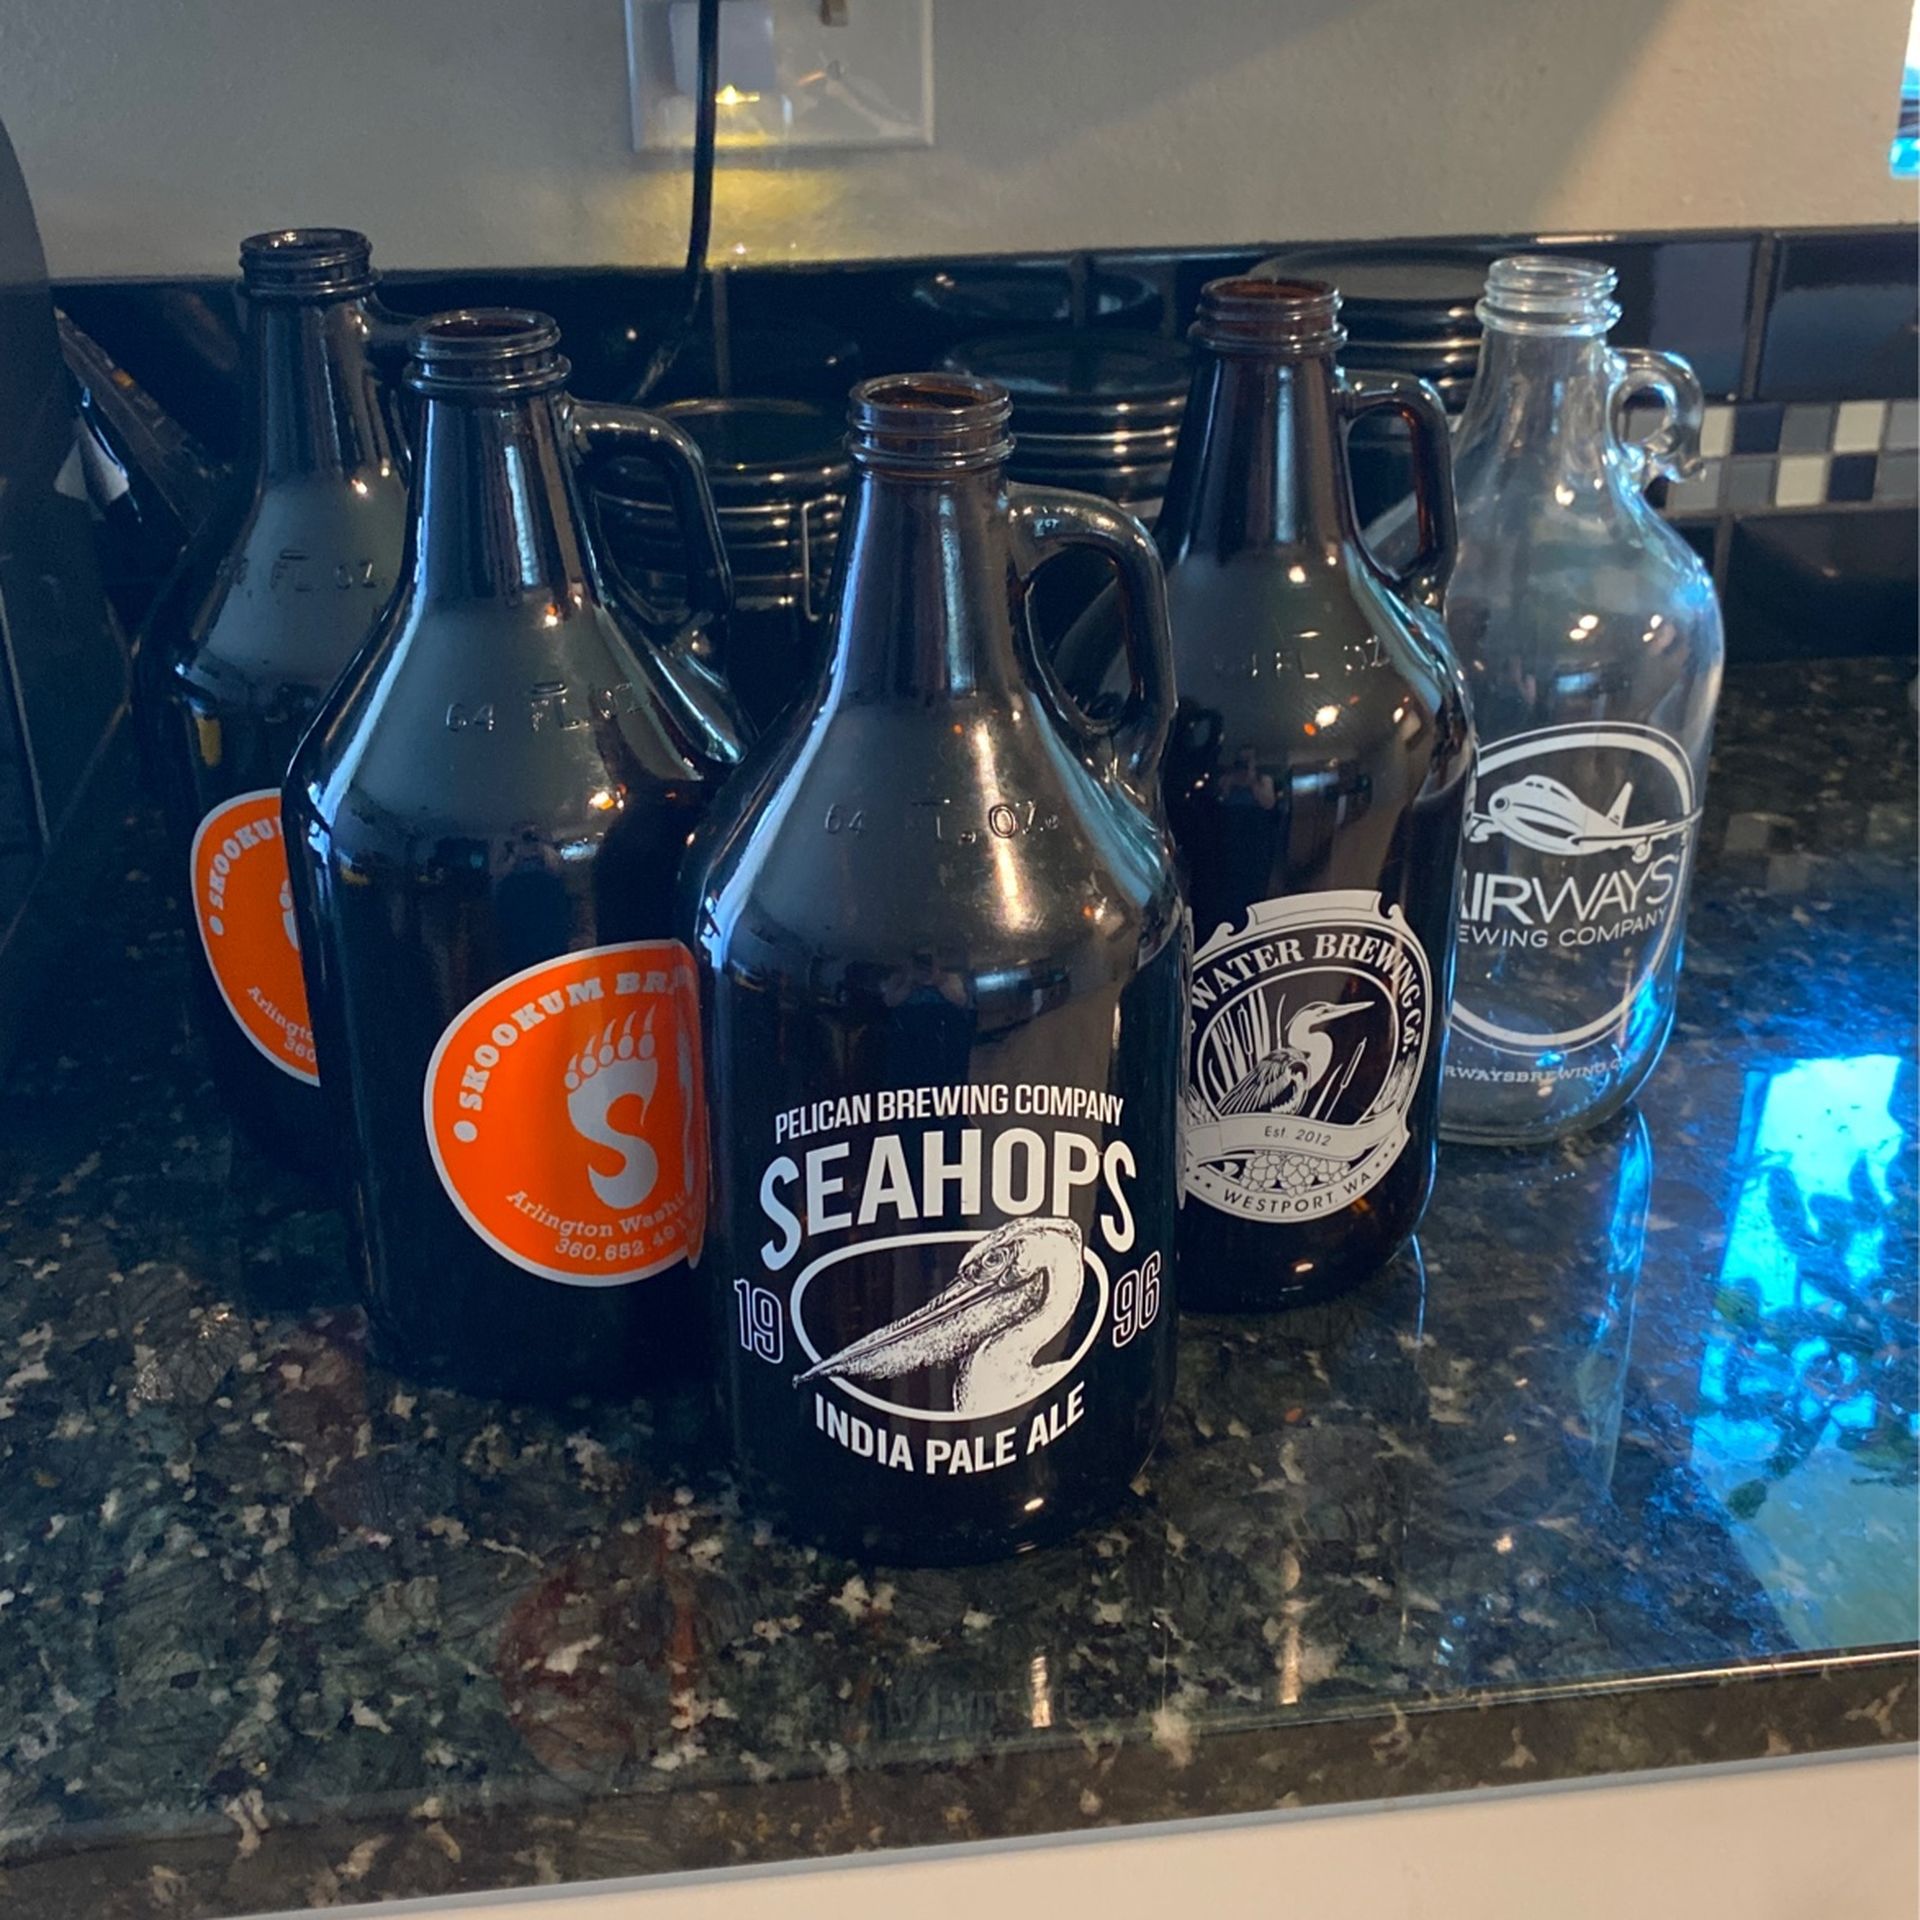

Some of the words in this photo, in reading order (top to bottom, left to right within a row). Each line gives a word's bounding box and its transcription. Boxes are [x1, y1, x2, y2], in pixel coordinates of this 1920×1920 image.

[446, 702, 495, 733] 64
[824, 802, 866, 836] 64
[1558, 904, 1670, 948] COMPANY
[1191, 936, 1305, 1010] WATER
[1312, 932, 1422, 1010] BREWING
[458, 976, 605, 1113] SKOOKUM
[774, 1091, 872, 1145] PELICAN
[876, 1083, 1009, 1123] BREWING
[1014, 1083, 1125, 1127] COMPANY
[1296, 1129, 1333, 1147] 2012
[506, 1190, 614, 1240] Arlington
[759, 1127, 1138, 1272] SEAHOPS
[1222, 1188, 1335, 1215] WESTPORT
[1342, 1171, 1372, 1196] WA
[733, 1277, 784, 1365] 19
[1112, 1250, 1162, 1349] 96
[813, 1392, 915, 1474] INDIA
[926, 1426, 1017, 1476] PALE
[1026, 1380, 1086, 1455] ALE
